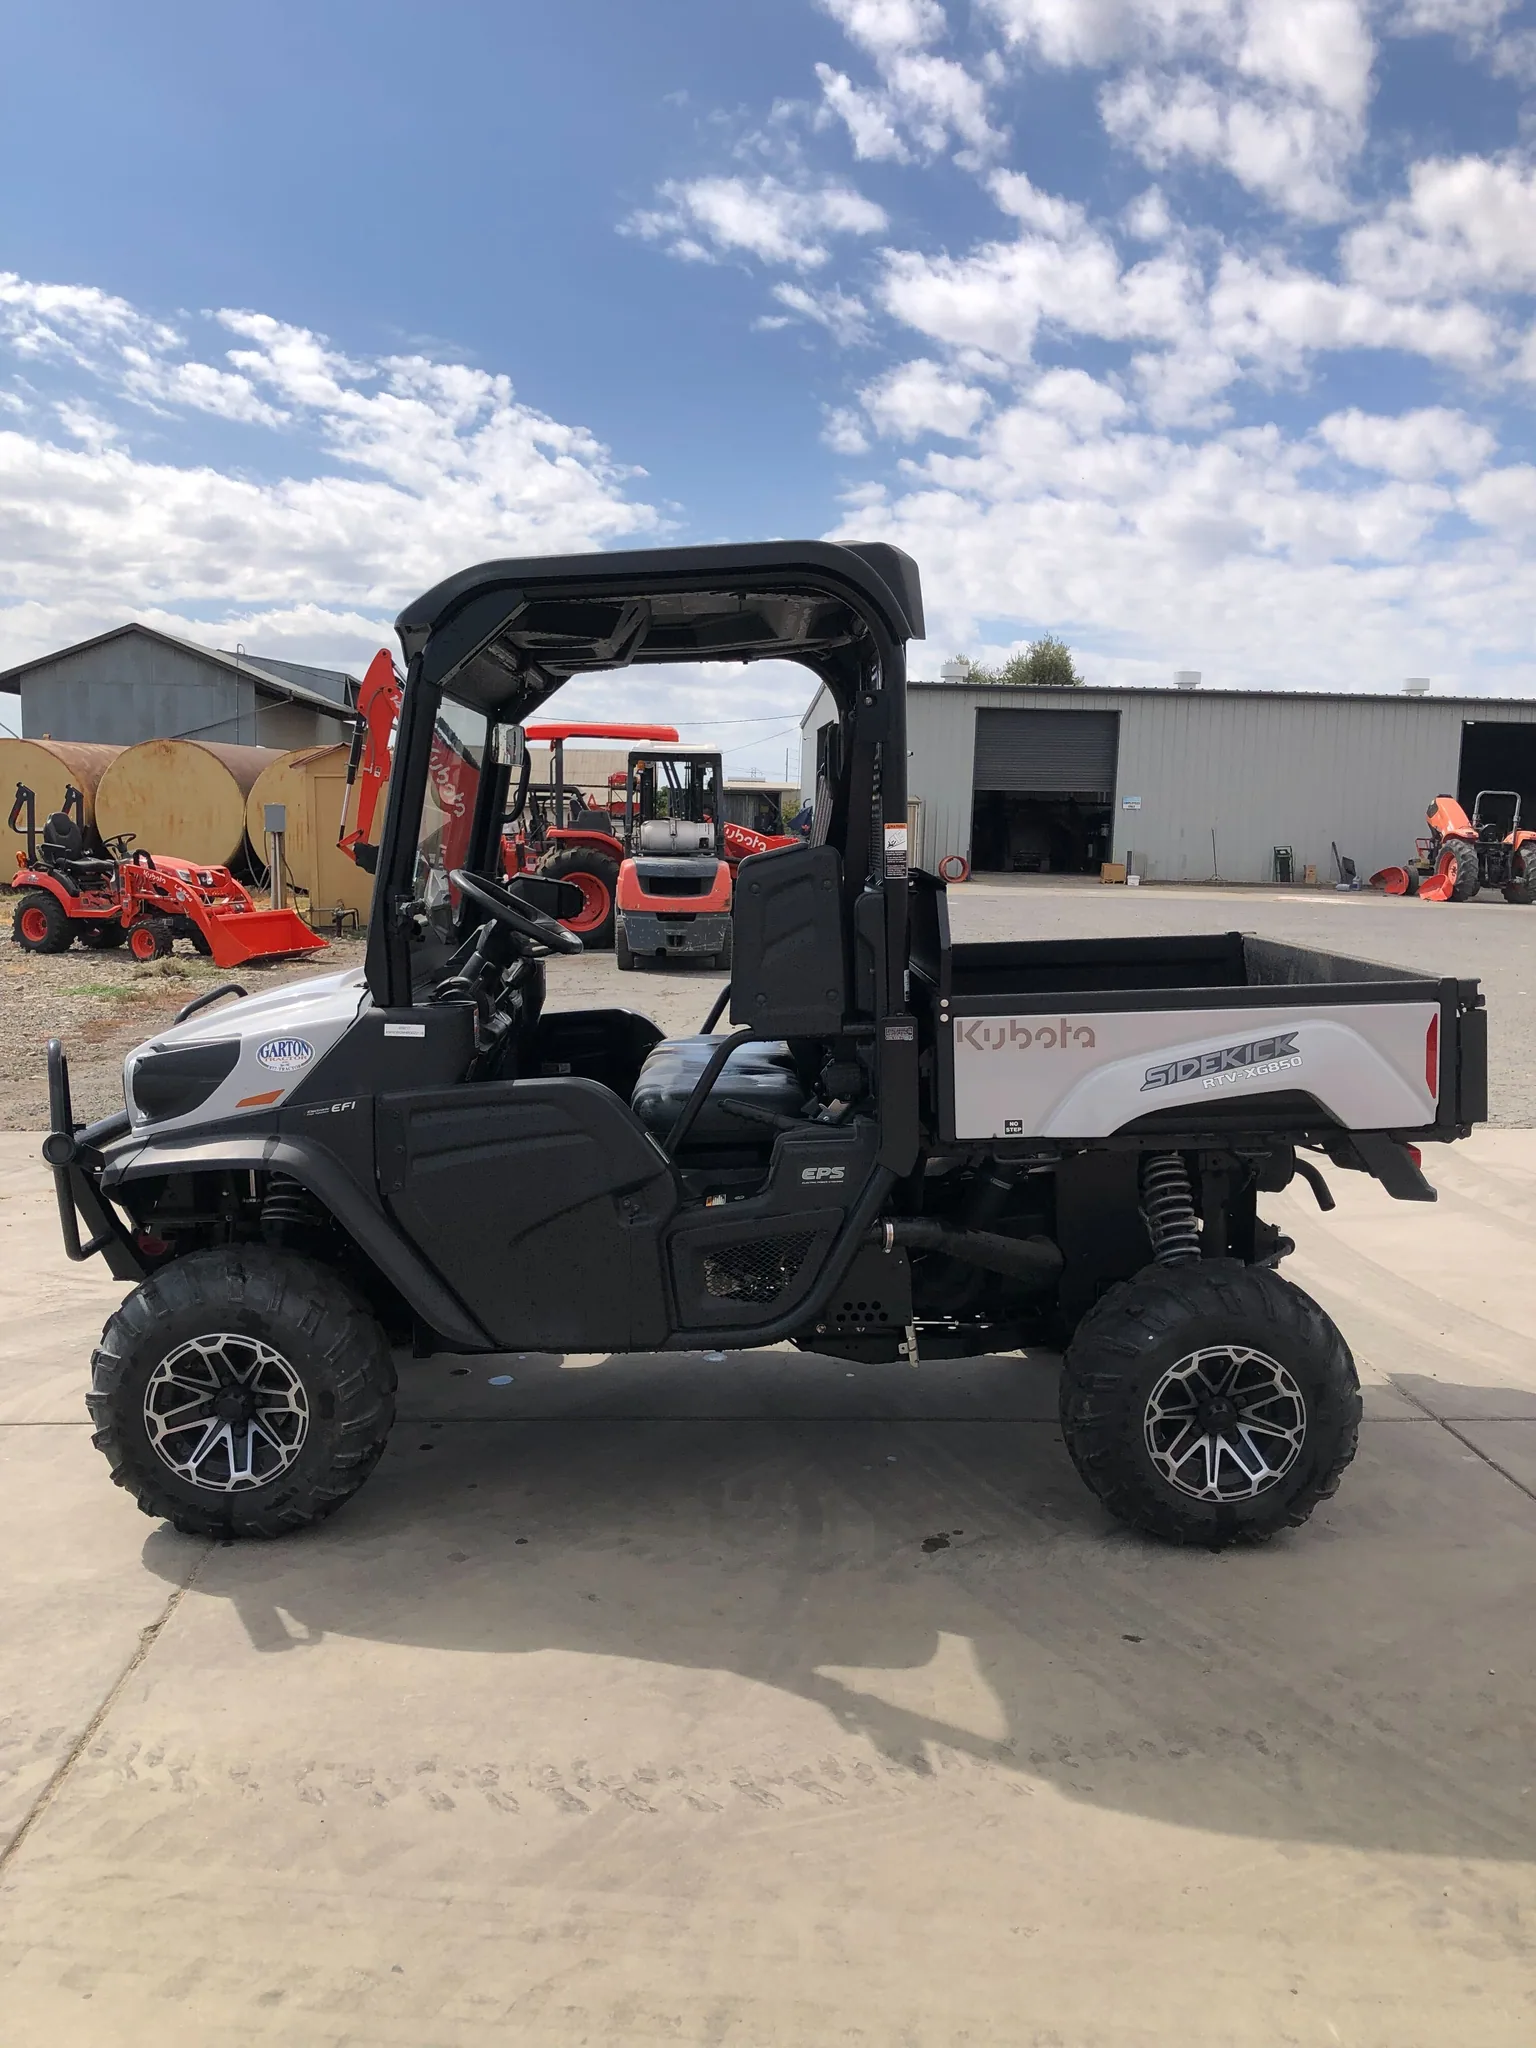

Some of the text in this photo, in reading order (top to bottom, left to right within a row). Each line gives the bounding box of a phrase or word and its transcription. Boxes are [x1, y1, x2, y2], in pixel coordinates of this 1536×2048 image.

[724, 824, 767, 853] ubota
[143, 869, 167, 885] Kubota
[956, 1017, 1096, 1051] Kubota
[260, 1040, 309, 1059] GARTON
[1140, 1031, 1300, 1092] SIDEKICK
[1202, 1056, 1303, 1089] RTV-XG850
[331, 1101, 356, 1113] EFI
[801, 1166, 846, 1180] EPS
